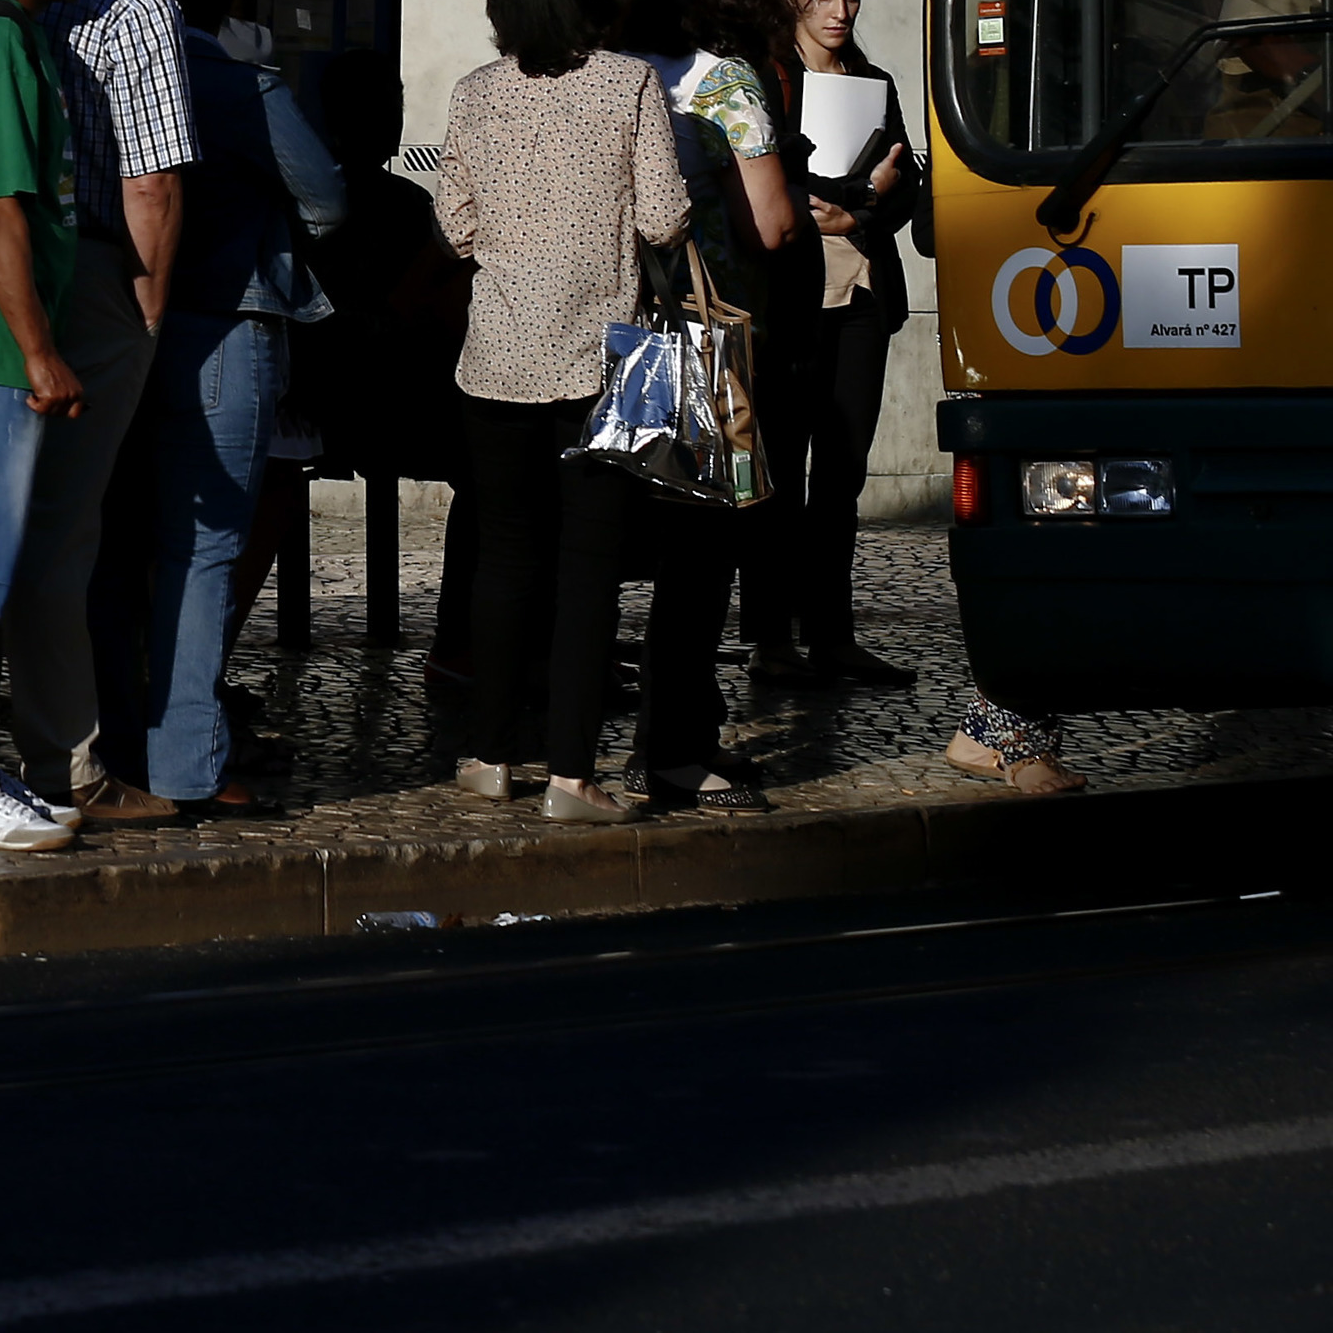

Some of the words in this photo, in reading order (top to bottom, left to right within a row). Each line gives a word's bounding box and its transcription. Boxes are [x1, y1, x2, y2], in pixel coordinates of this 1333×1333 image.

[1177, 267, 1235, 309] TP
[1150, 323, 1193, 336] Alvará
[1211, 323, 1237, 336] 427
